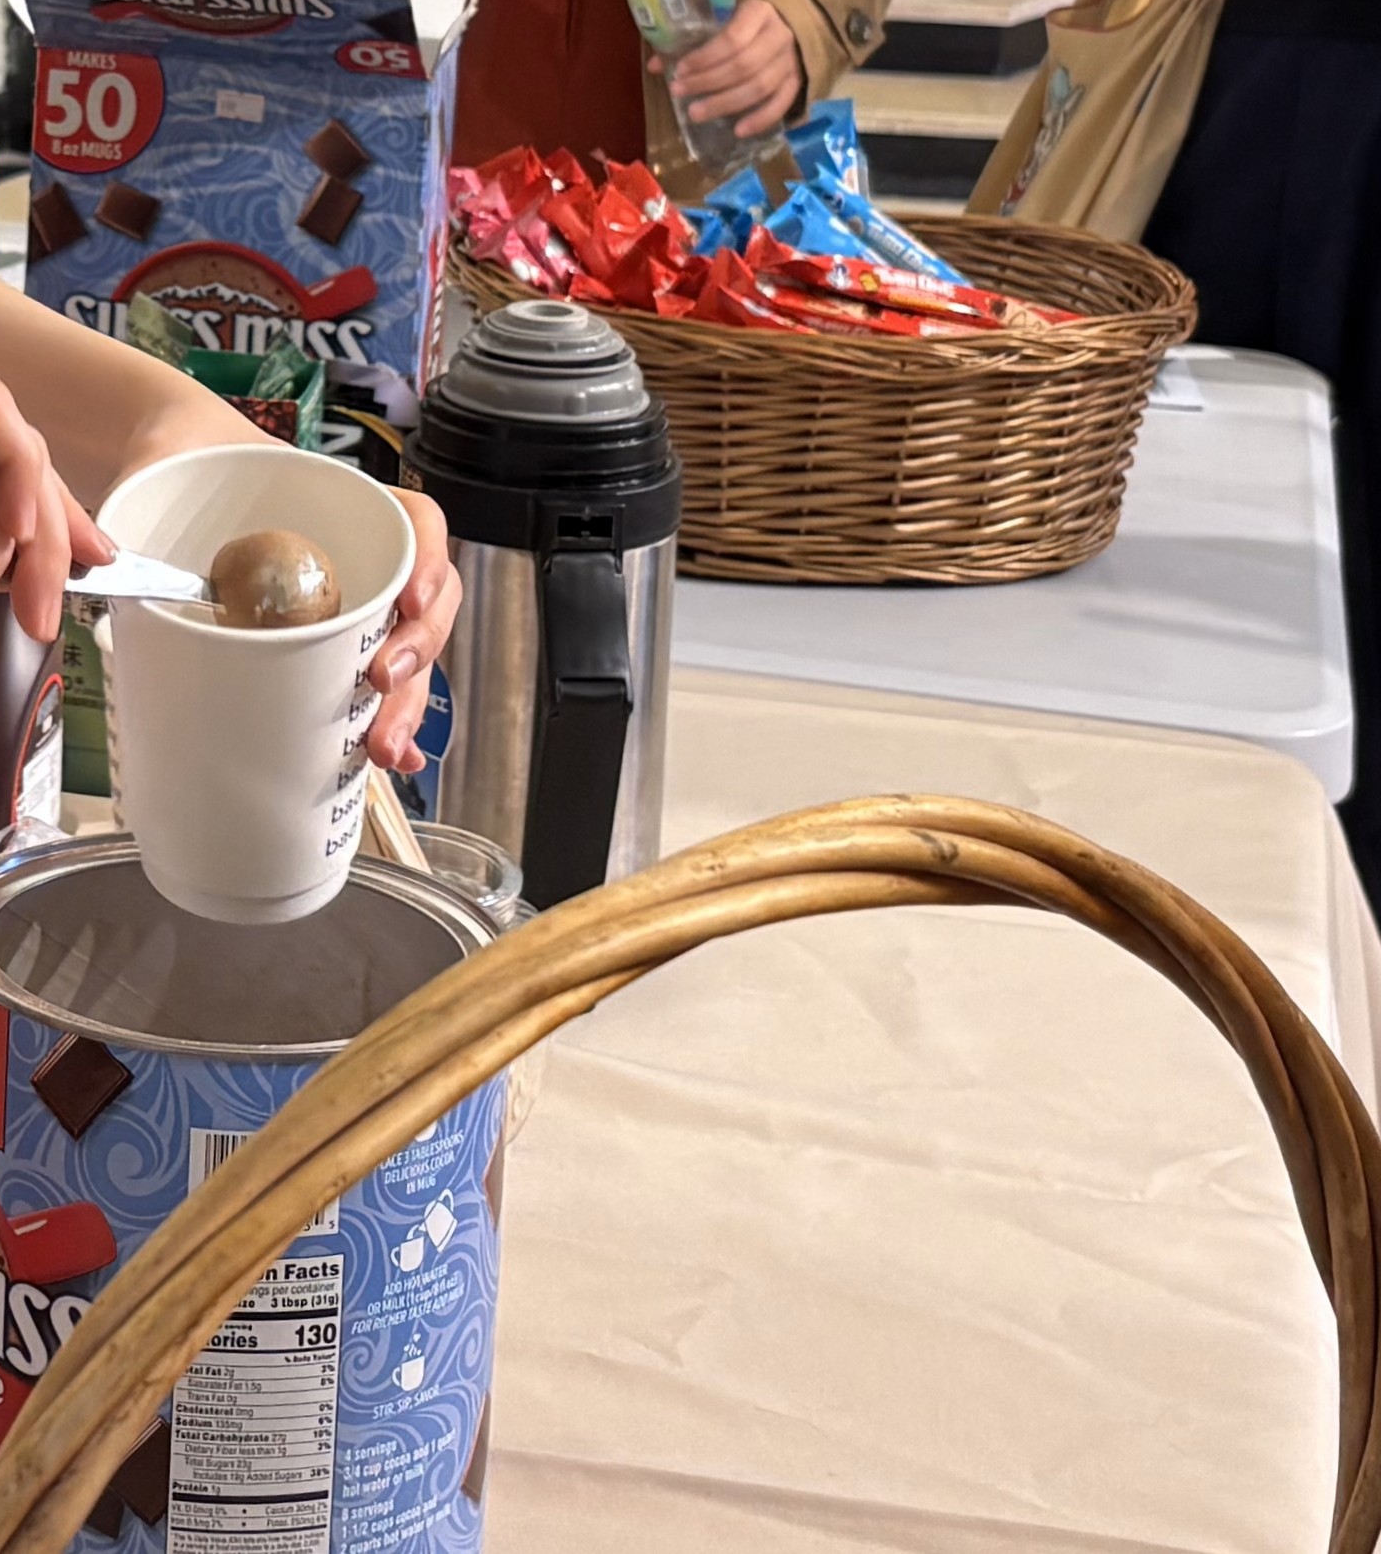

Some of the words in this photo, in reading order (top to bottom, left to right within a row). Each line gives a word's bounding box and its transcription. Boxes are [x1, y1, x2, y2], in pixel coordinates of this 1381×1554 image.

[68, 51, 117, 70] MAKES
[349, 45, 411, 71] 50
[44, 69, 137, 143] 50
[80, 140, 122, 161] MUGS
[411, 1129, 465, 1159] TABLESPOONS
[384, 1159, 430, 1184] DELICIOUS
[431, 1150, 455, 1172] COCOA
[405, 1181, 416, 1195] IN
[417, 1173, 437, 1192] MUG
[284, 1262, 340, 1280] Facts
[383, 1281, 402, 1297] ADD
[422, 1263, 448, 1285] WATER
[272, 1285, 288, 1297] per
[291, 1282, 335, 1295] container
[270, 1298, 279, 1309] 3
[281, 1296, 308, 1309] tbsp
[311, 1293, 339, 1308] (31g)
[367, 1301, 380, 1316] OR
[382, 1295, 405, 1312] MILK
[351, 1319, 372, 1335] FOR
[373, 1309, 407, 1331] RICHER
[295, 1322, 337, 1347] 130
[205, 1366, 222, 1376] Fat
[188, 1391, 210, 1402] Trans
[175, 1404, 234, 1416] Cholesterol
[319, 1402, 334, 1412] 0%
[175, 1416, 213, 1428] Sodium
[175, 1430, 200, 1440] Total
[202, 1431, 269, 1444] Carbohydrate
[185, 1444, 214, 1456] Dietary
[216, 1444, 237, 1455] Fiber
[353, 1440, 397, 1461] servings
[363, 1461, 382, 1477] cup
[384, 1452, 411, 1471] cocoa
[413, 1442, 429, 1461] and
[185, 1457, 204, 1466] Total
[205, 1457, 235, 1469] Sugars
[172, 1482, 209, 1493] Protein
[342, 1482, 360, 1499] hot
[362, 1475, 391, 1494] water
[393, 1472, 403, 1485] or
[405, 1463, 424, 1482] milk
[351, 1498, 395, 1520] servings
[371, 1516, 394, 1534] cups
[395, 1505, 421, 1526] cocoa
[383, 1529, 399, 1546] hot
[401, 1519, 425, 1541] water
[426, 1514, 435, 1529] or
